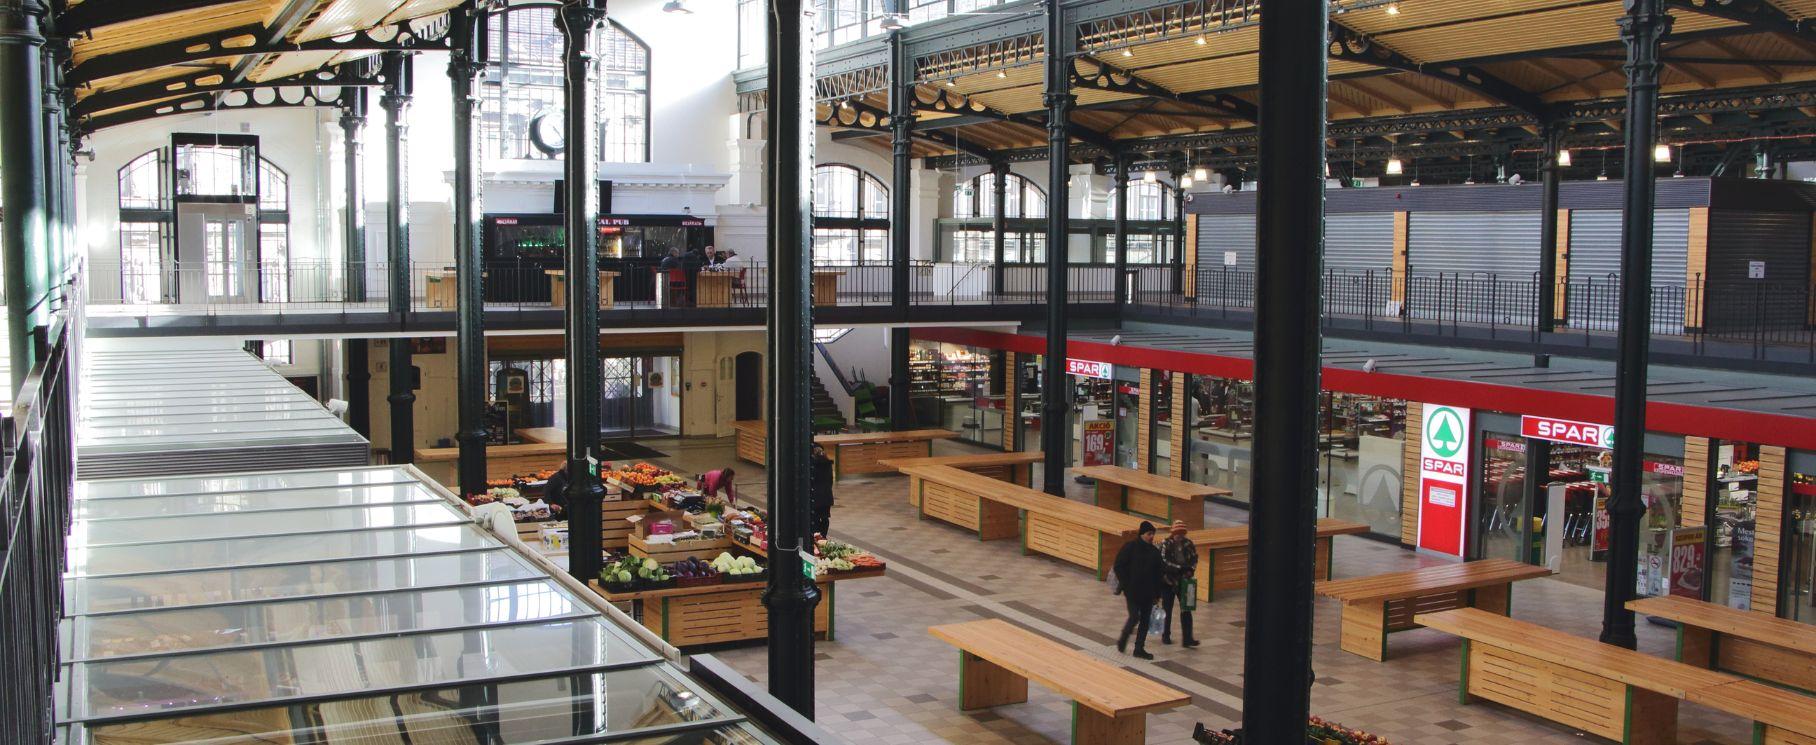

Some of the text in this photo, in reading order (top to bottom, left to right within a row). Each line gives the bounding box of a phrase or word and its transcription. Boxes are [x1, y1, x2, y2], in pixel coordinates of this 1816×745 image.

[613, 218, 630, 226] PUB
[1069, 361, 1099, 375] SPAR
[1537, 421, 1598, 442] SPAR
[1501, 441, 1520, 449] SPAR
[1424, 459, 1464, 475] SPAR
[1658, 463, 1682, 472] SPAR
